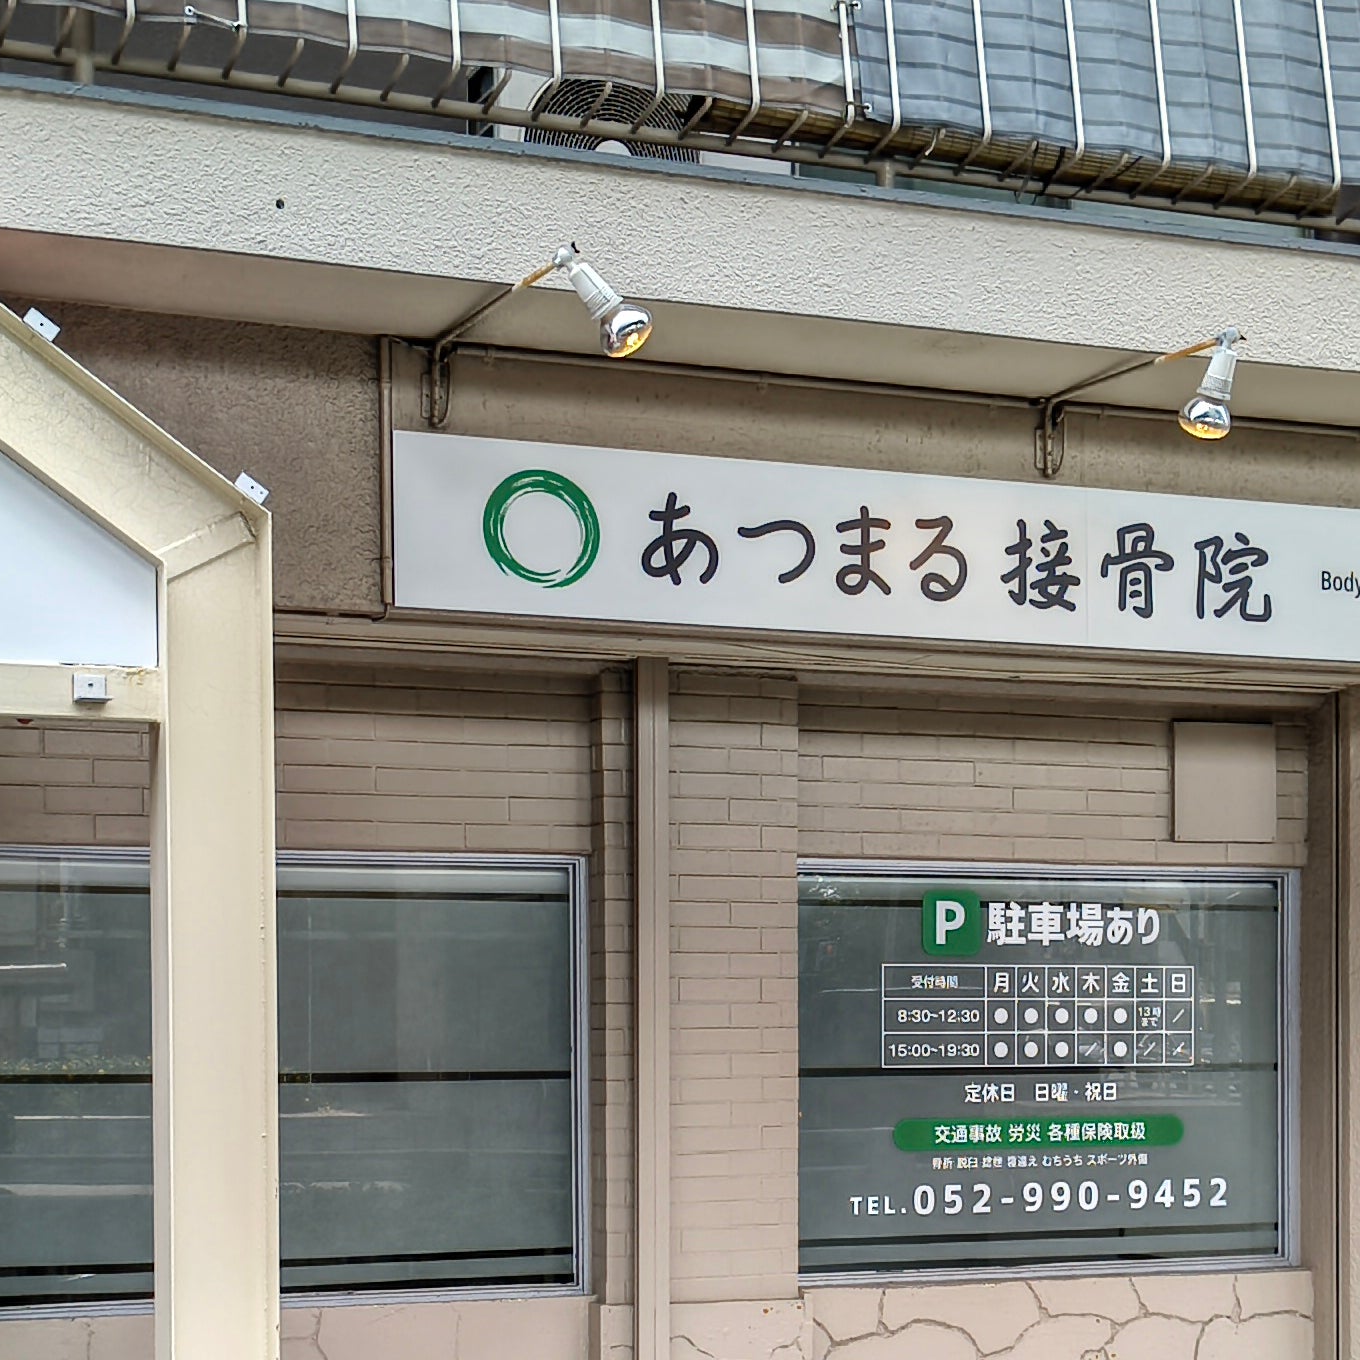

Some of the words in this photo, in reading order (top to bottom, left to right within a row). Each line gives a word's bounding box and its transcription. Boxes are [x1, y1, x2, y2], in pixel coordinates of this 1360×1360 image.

[935, 901, 965, 944] P
[986, 902, 1160, 946] 駐車場あり
[911, 975, 958, 989] 受付時間
[993, 972, 1009, 993] 月
[1021, 972, 1040, 993] 火
[1051, 972, 1070, 993] 水
[1081, 972, 1100, 993] 木
[1111, 972, 1130, 993] 金
[1141, 972, 1159, 993] 土
[1171, 973, 1186, 993] 日
[964, 1082, 1015, 1103] 定休日
[934, 1124, 1002, 1144] 交通事故
[1009, 1124, 1042, 1142] 労災
[1047, 1122, 1146, 1142] 各種保険取扱
[1042, 1154, 1083, 1167] むちうち
